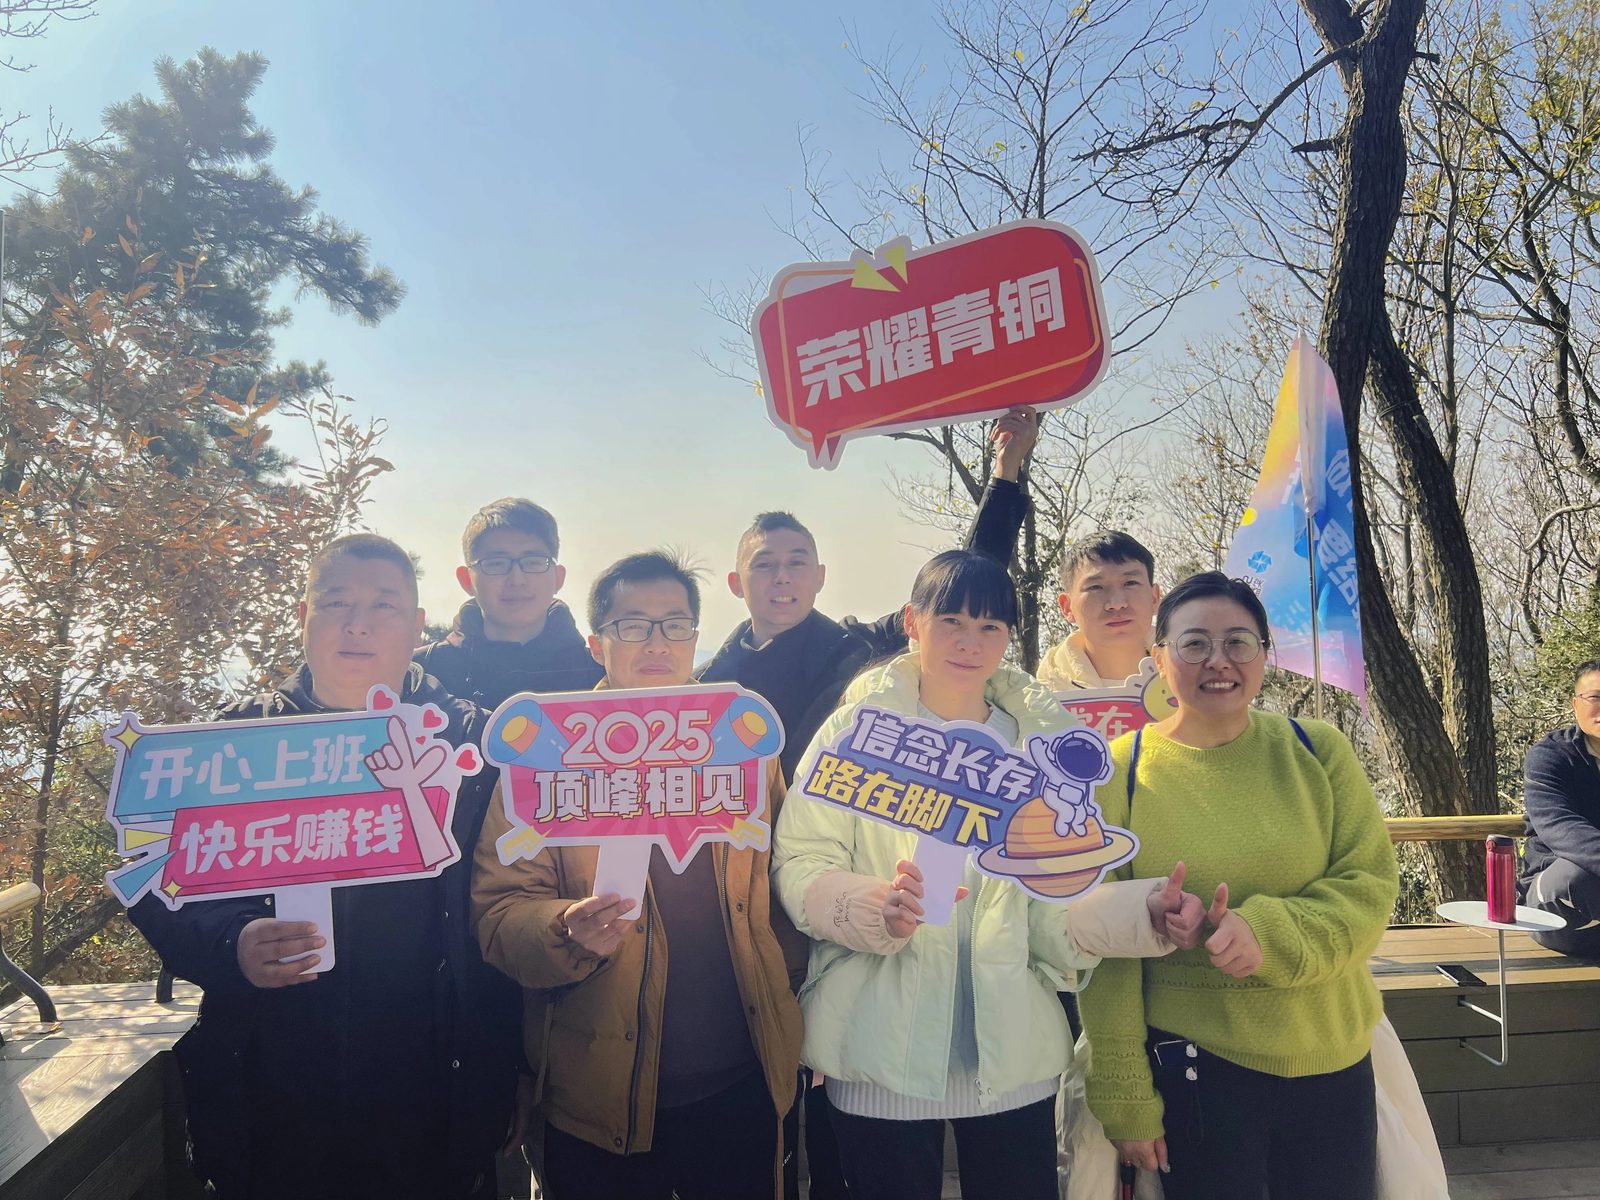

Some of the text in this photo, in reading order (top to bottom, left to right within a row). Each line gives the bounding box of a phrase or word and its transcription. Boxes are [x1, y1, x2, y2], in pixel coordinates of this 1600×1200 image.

[796, 267, 1066, 408] 荣耀青铜
[562, 709, 714, 768] 2025
[849, 710, 1040, 801] 信念长存
[1069, 706, 1132, 739] 在
[140, 734, 367, 800] 开心上班
[534, 765, 749, 823] 顶峰相见
[806, 754, 1000, 845] 路在脚下
[179, 803, 404, 875] 快乐赚钱
